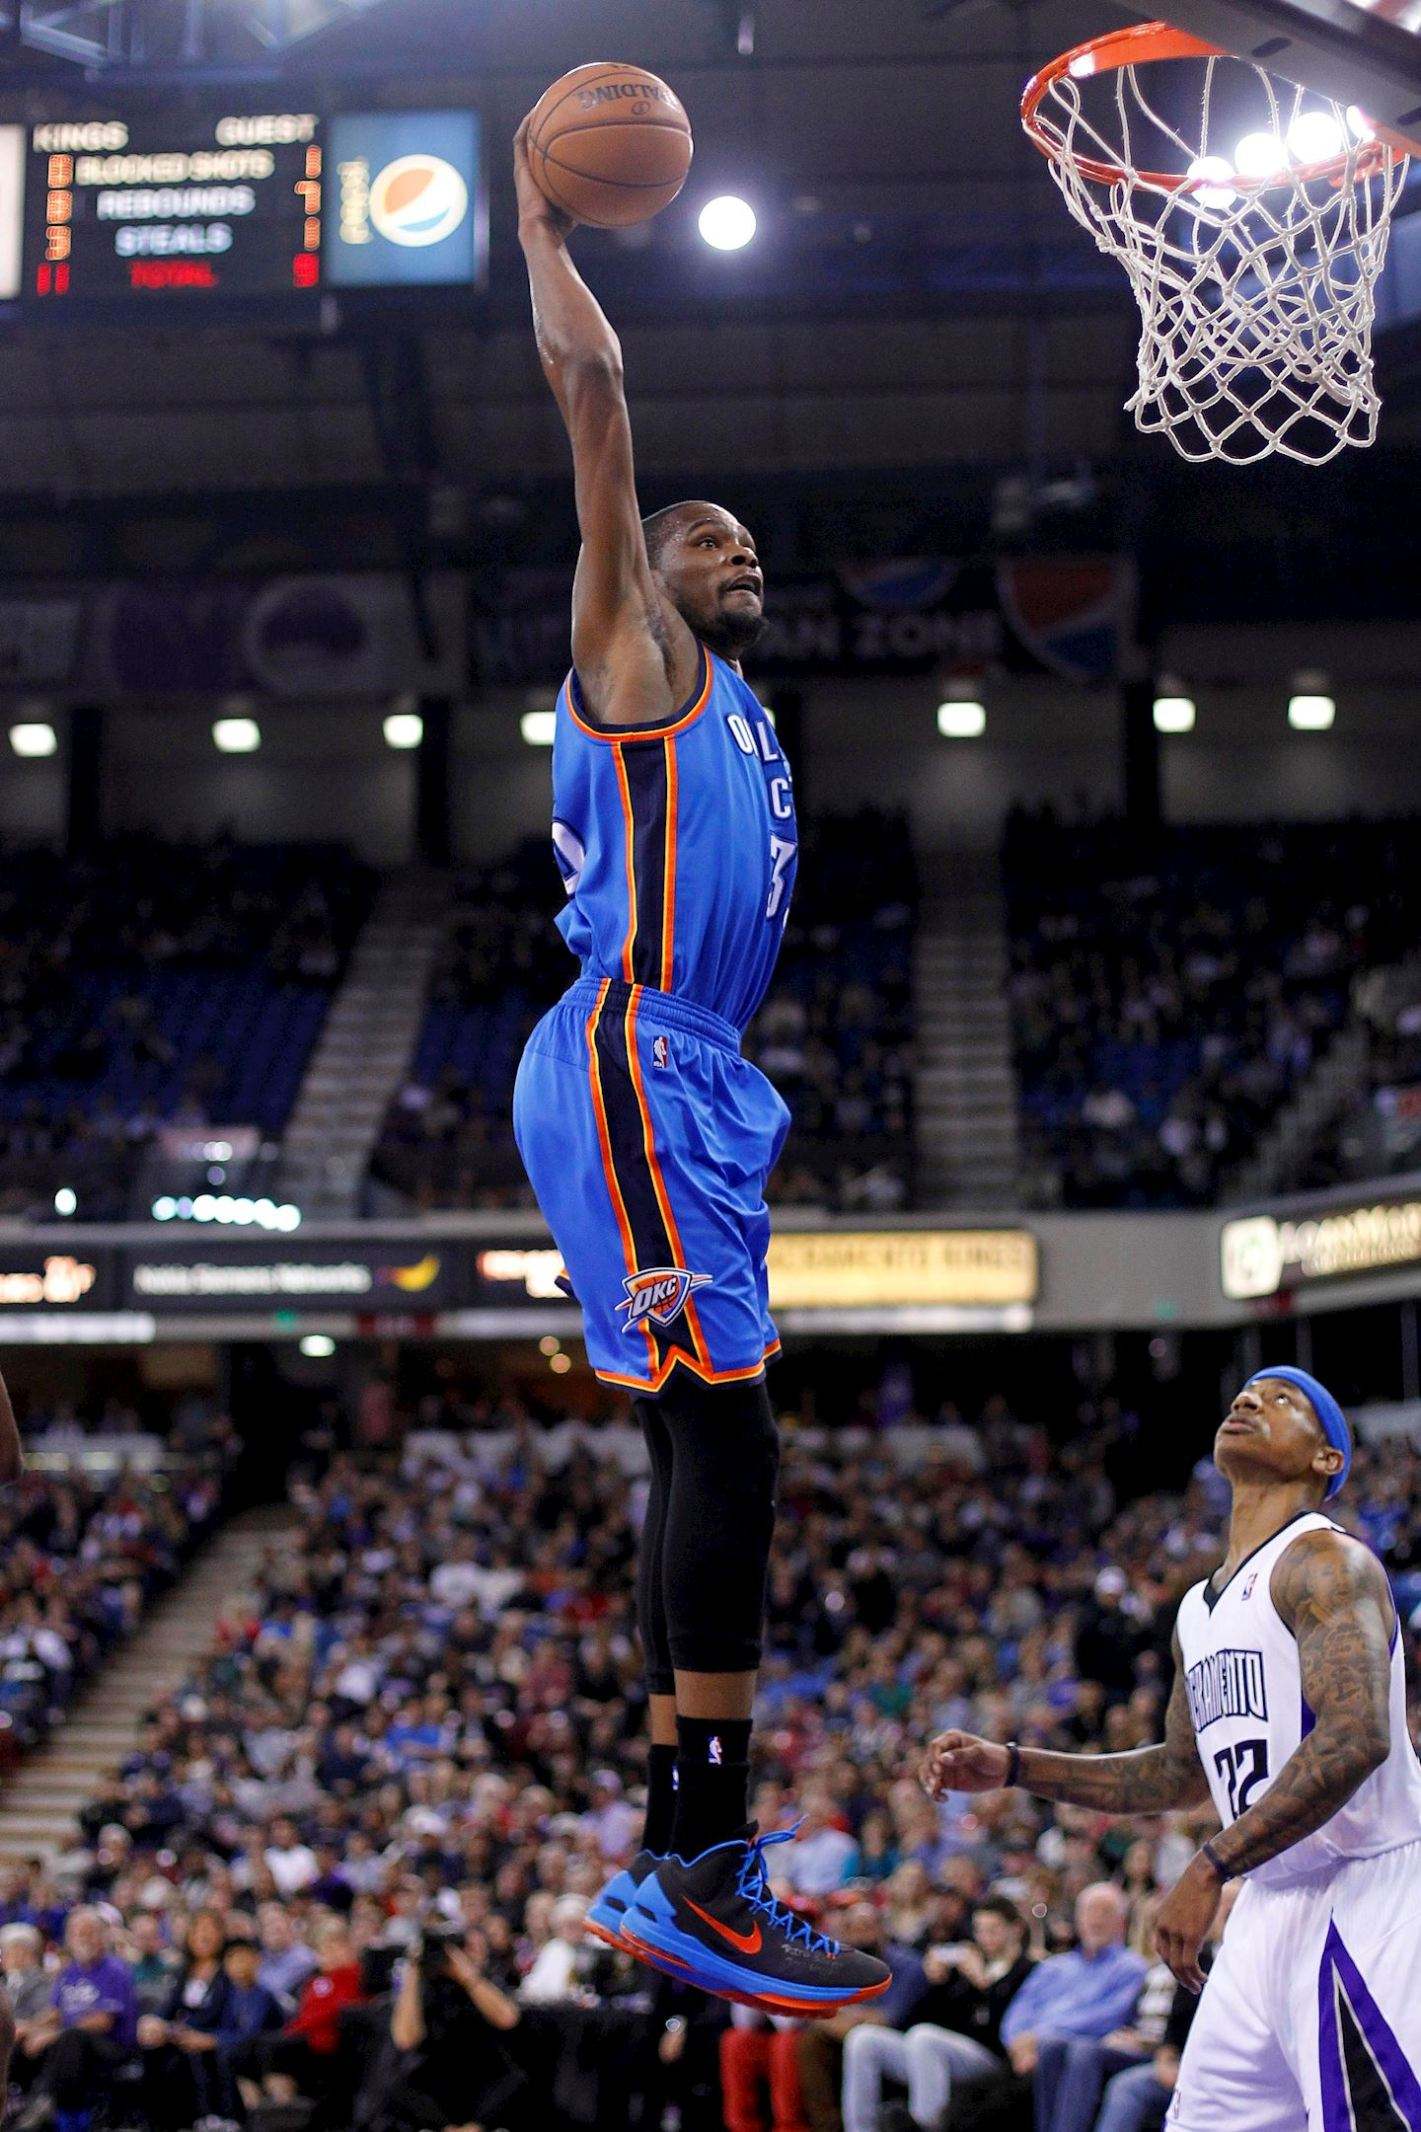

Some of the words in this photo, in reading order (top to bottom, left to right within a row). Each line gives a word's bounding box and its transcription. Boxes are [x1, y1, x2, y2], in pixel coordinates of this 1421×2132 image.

[33, 121, 129, 153] KINGS
[215, 114, 319, 147] GUEST
[75, 152, 189, 186] BLOCKED
[189, 149, 275, 181] SHOTS
[97, 185, 256, 221] REBOUNDS
[115, 222, 233, 257] STEALS
[631, 1277, 677, 1318] OKC
